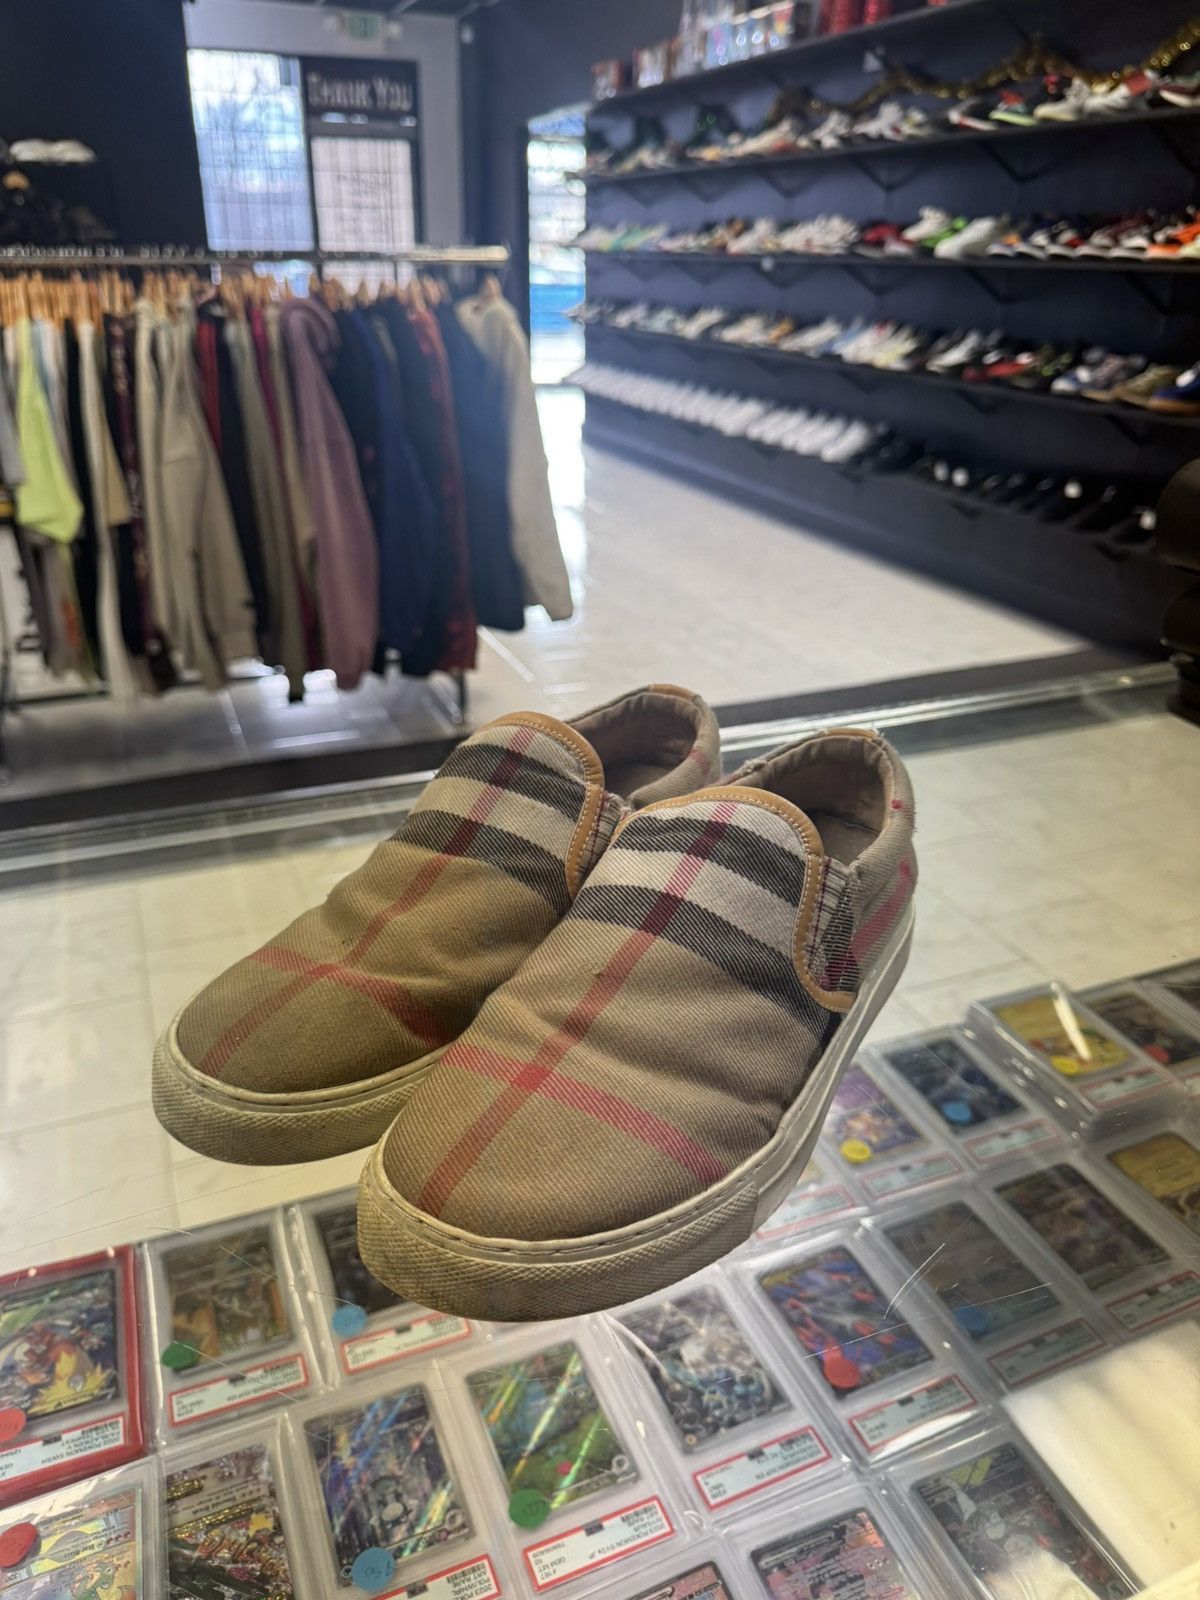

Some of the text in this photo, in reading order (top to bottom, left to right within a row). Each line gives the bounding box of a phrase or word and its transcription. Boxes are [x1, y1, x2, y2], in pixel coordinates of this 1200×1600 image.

[452, 1570, 488, 1588] ART RARE
[475, 1584, 492, 1597] 2023
